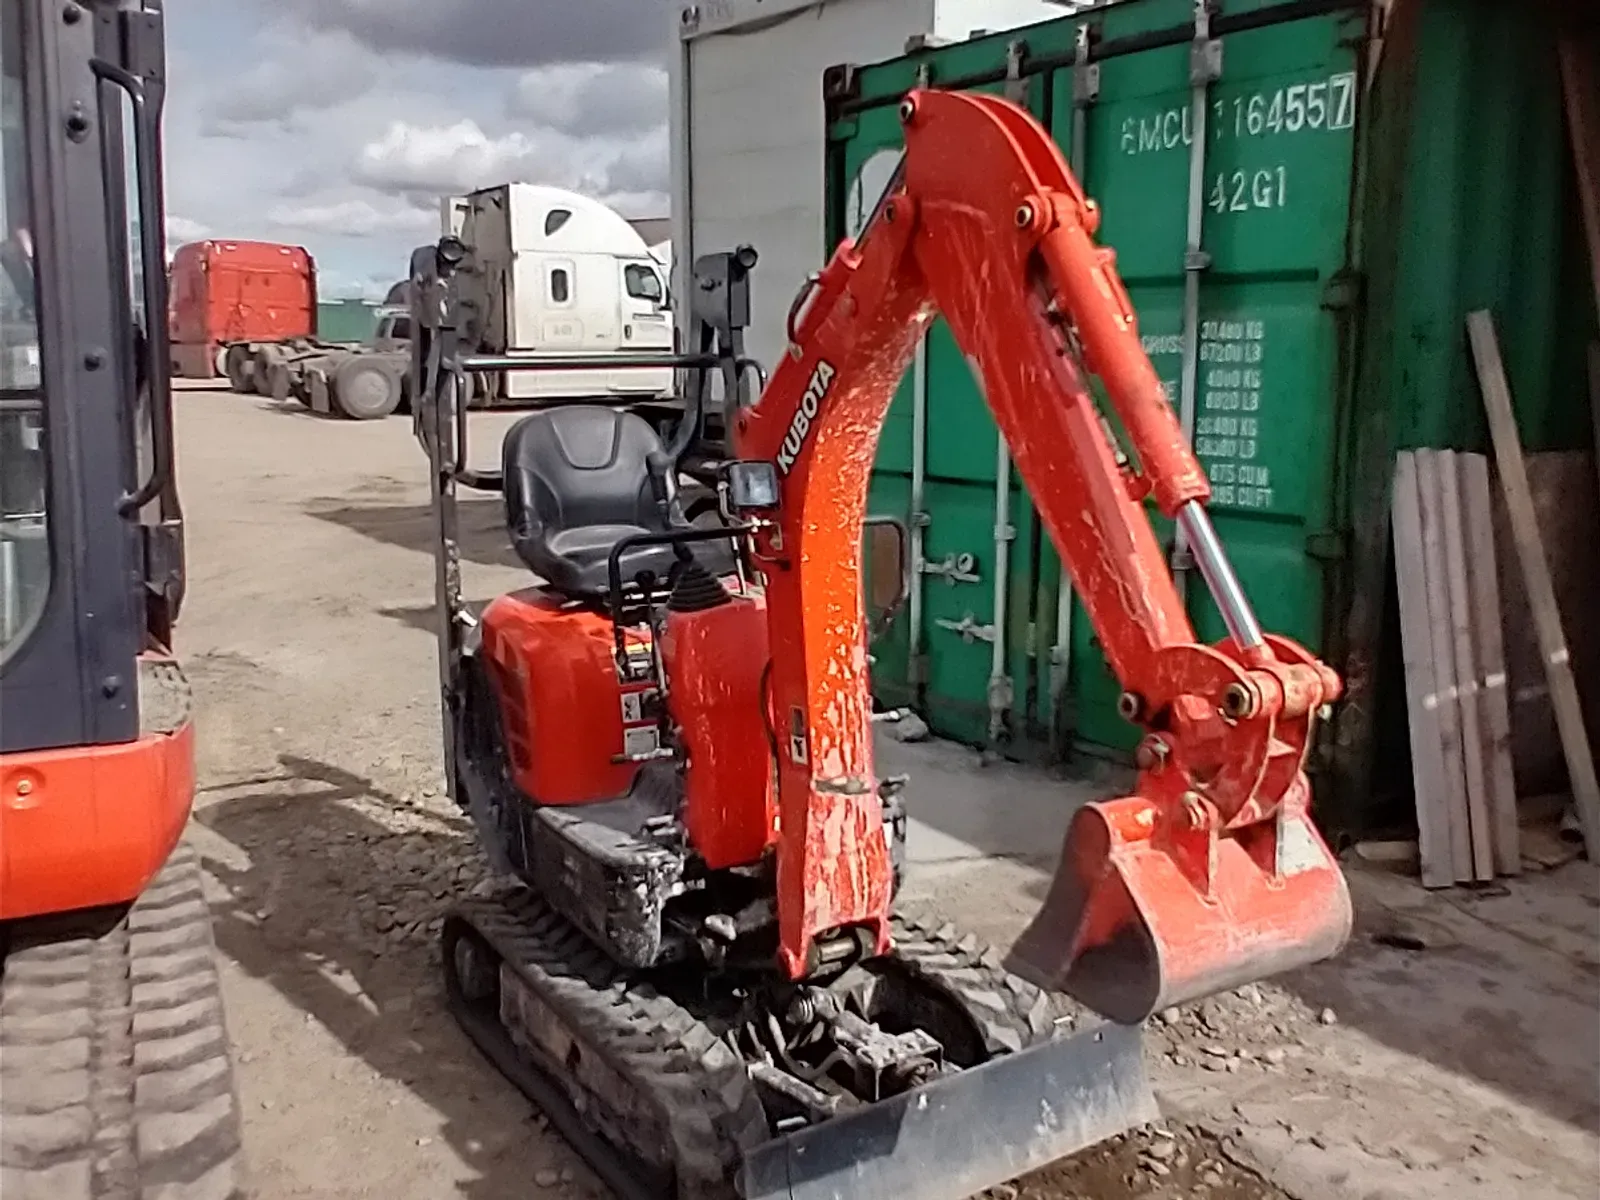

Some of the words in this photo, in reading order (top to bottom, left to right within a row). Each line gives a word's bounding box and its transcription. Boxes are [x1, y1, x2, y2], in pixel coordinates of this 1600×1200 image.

[1209, 166, 1286, 213] 42G1
[1245, 321, 1264, 340] KG
[1243, 369, 1261, 388] KG
[777, 360, 835, 474] KUBOTA
[1239, 417, 1258, 437] KG
